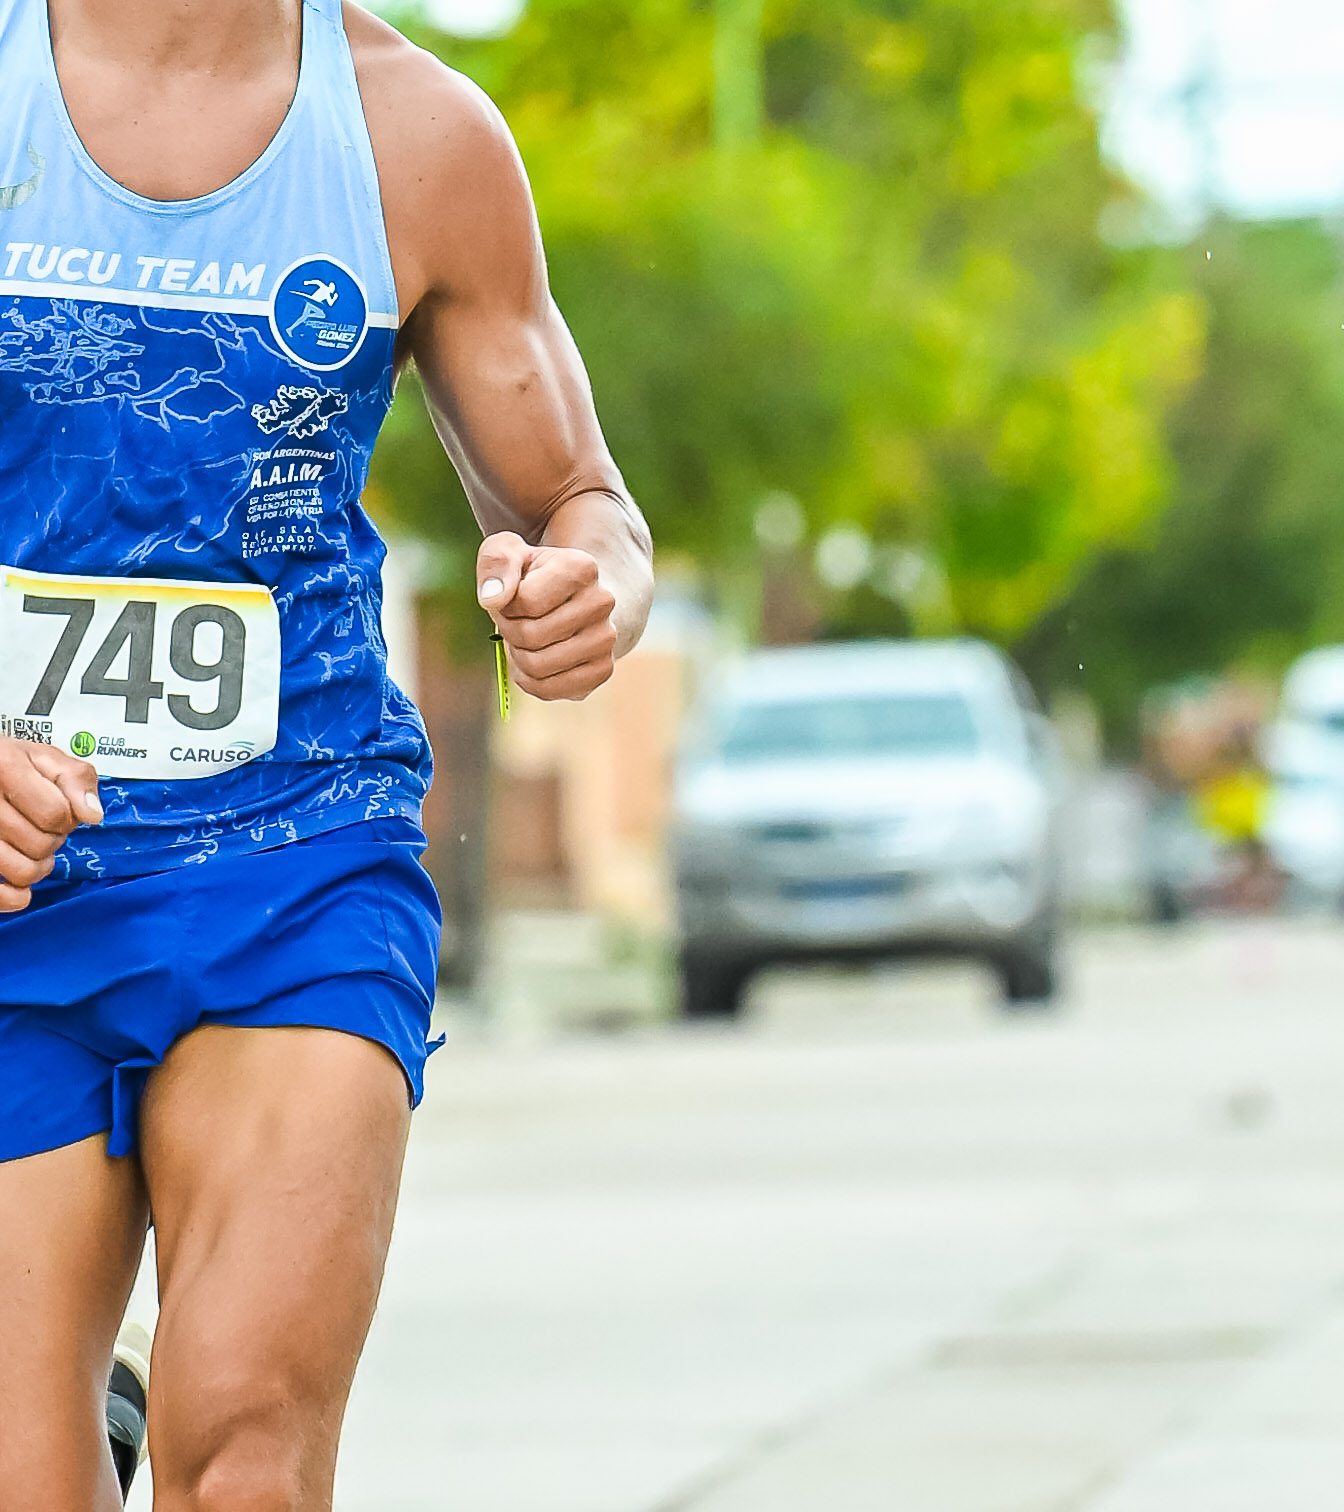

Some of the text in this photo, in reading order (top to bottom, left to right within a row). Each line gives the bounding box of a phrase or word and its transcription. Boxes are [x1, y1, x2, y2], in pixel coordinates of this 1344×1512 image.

[5, 241, 266, 297] TUCU TEAM
[273, 448, 336, 461] ARGENTINAS
[250, 463, 325, 490] A.A.I.M.
[23, 594, 246, 731] 749
[98, 736, 125, 747] CLUB
[169, 746, 252, 763] CARUSO
